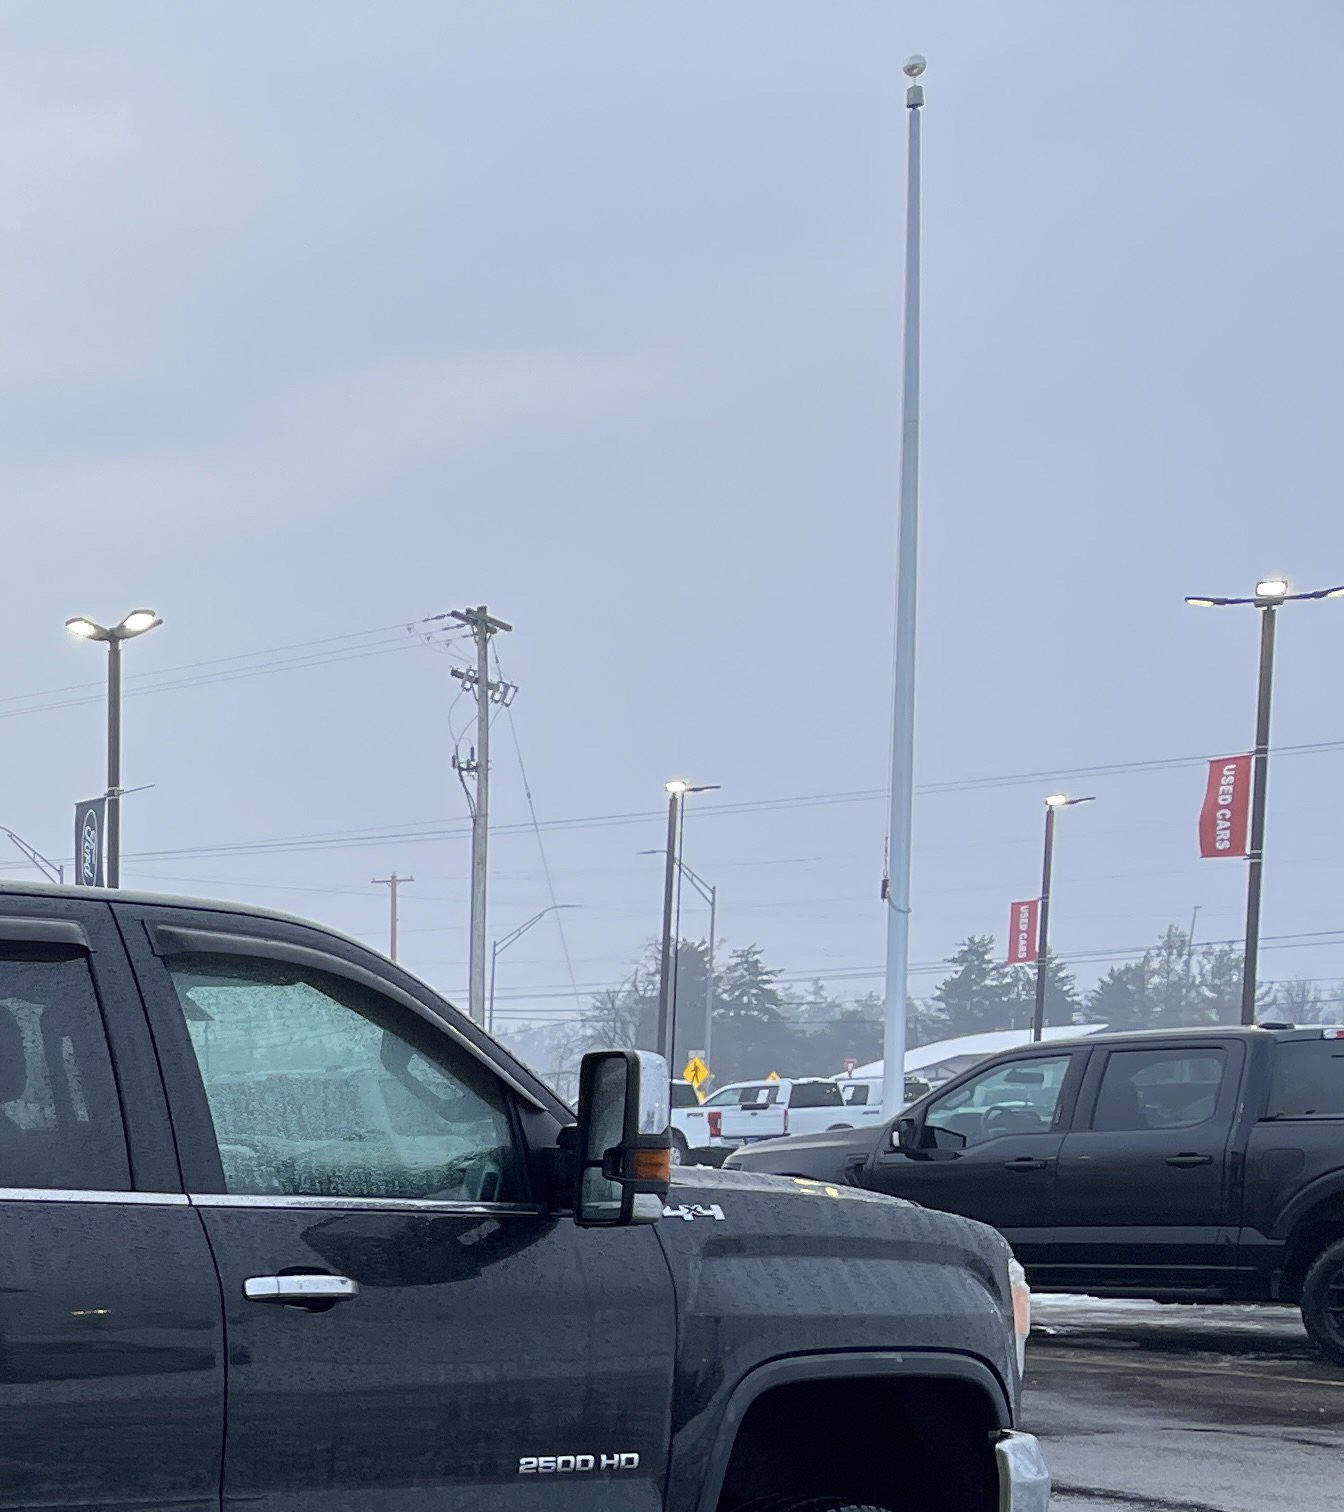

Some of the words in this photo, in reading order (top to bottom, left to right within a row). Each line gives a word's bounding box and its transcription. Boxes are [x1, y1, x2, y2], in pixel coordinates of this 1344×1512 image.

[1218, 764, 1236, 805] USED
[1216, 809, 1231, 850] CARS
[84, 825, 96, 878] Ford
[1019, 905, 1029, 931] USED
[1018, 932, 1028, 959] CARS
[519, 1455, 594, 1475] 2500
[600, 1453, 640, 1471] HD
